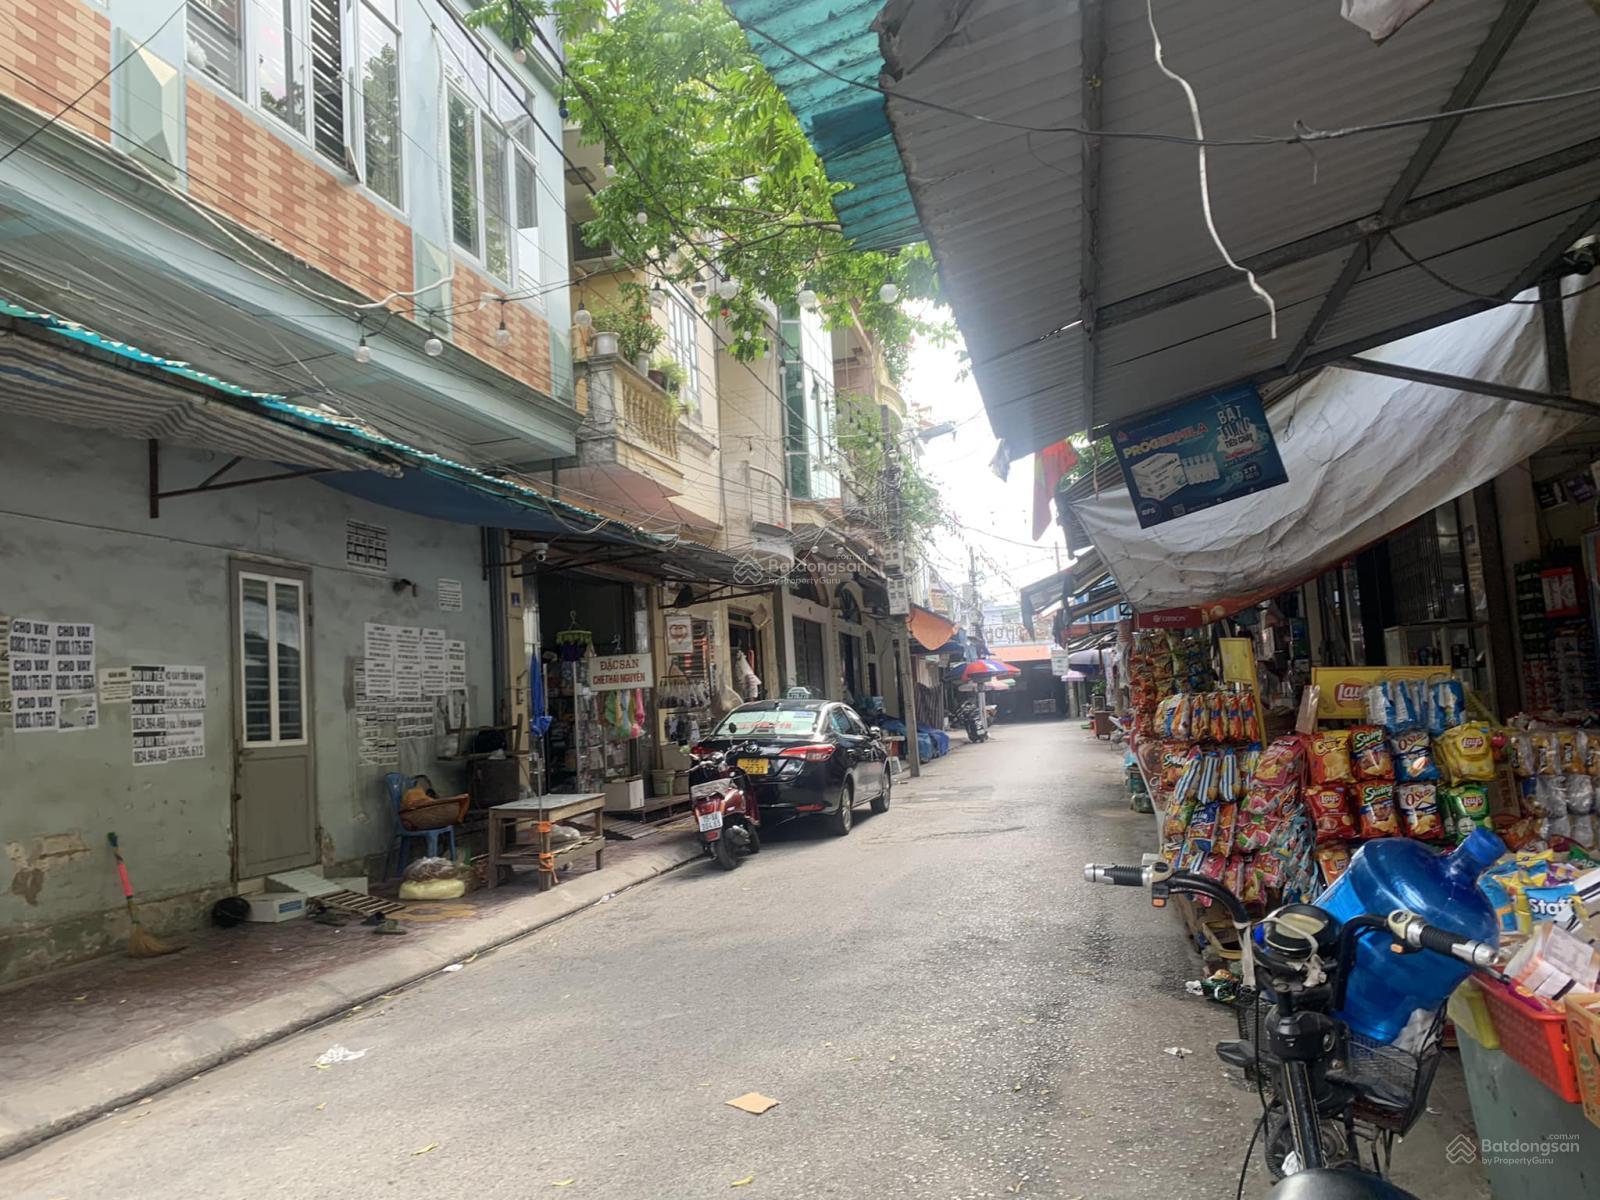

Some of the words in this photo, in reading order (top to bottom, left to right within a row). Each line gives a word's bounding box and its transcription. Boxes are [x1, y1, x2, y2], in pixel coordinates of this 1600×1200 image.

[13, 621, 31, 634] CHO
[33, 624, 48, 635] VAY
[57, 625, 74, 637] CHO
[76, 626, 91, 637] VAY
[14, 660, 32, 672] CHO
[34, 660, 49, 671] VAY
[58, 660, 74, 672] CHO
[76, 660, 91, 671] VAY
[17, 697, 36, 709] CHO
[38, 696, 53, 708] VAY
